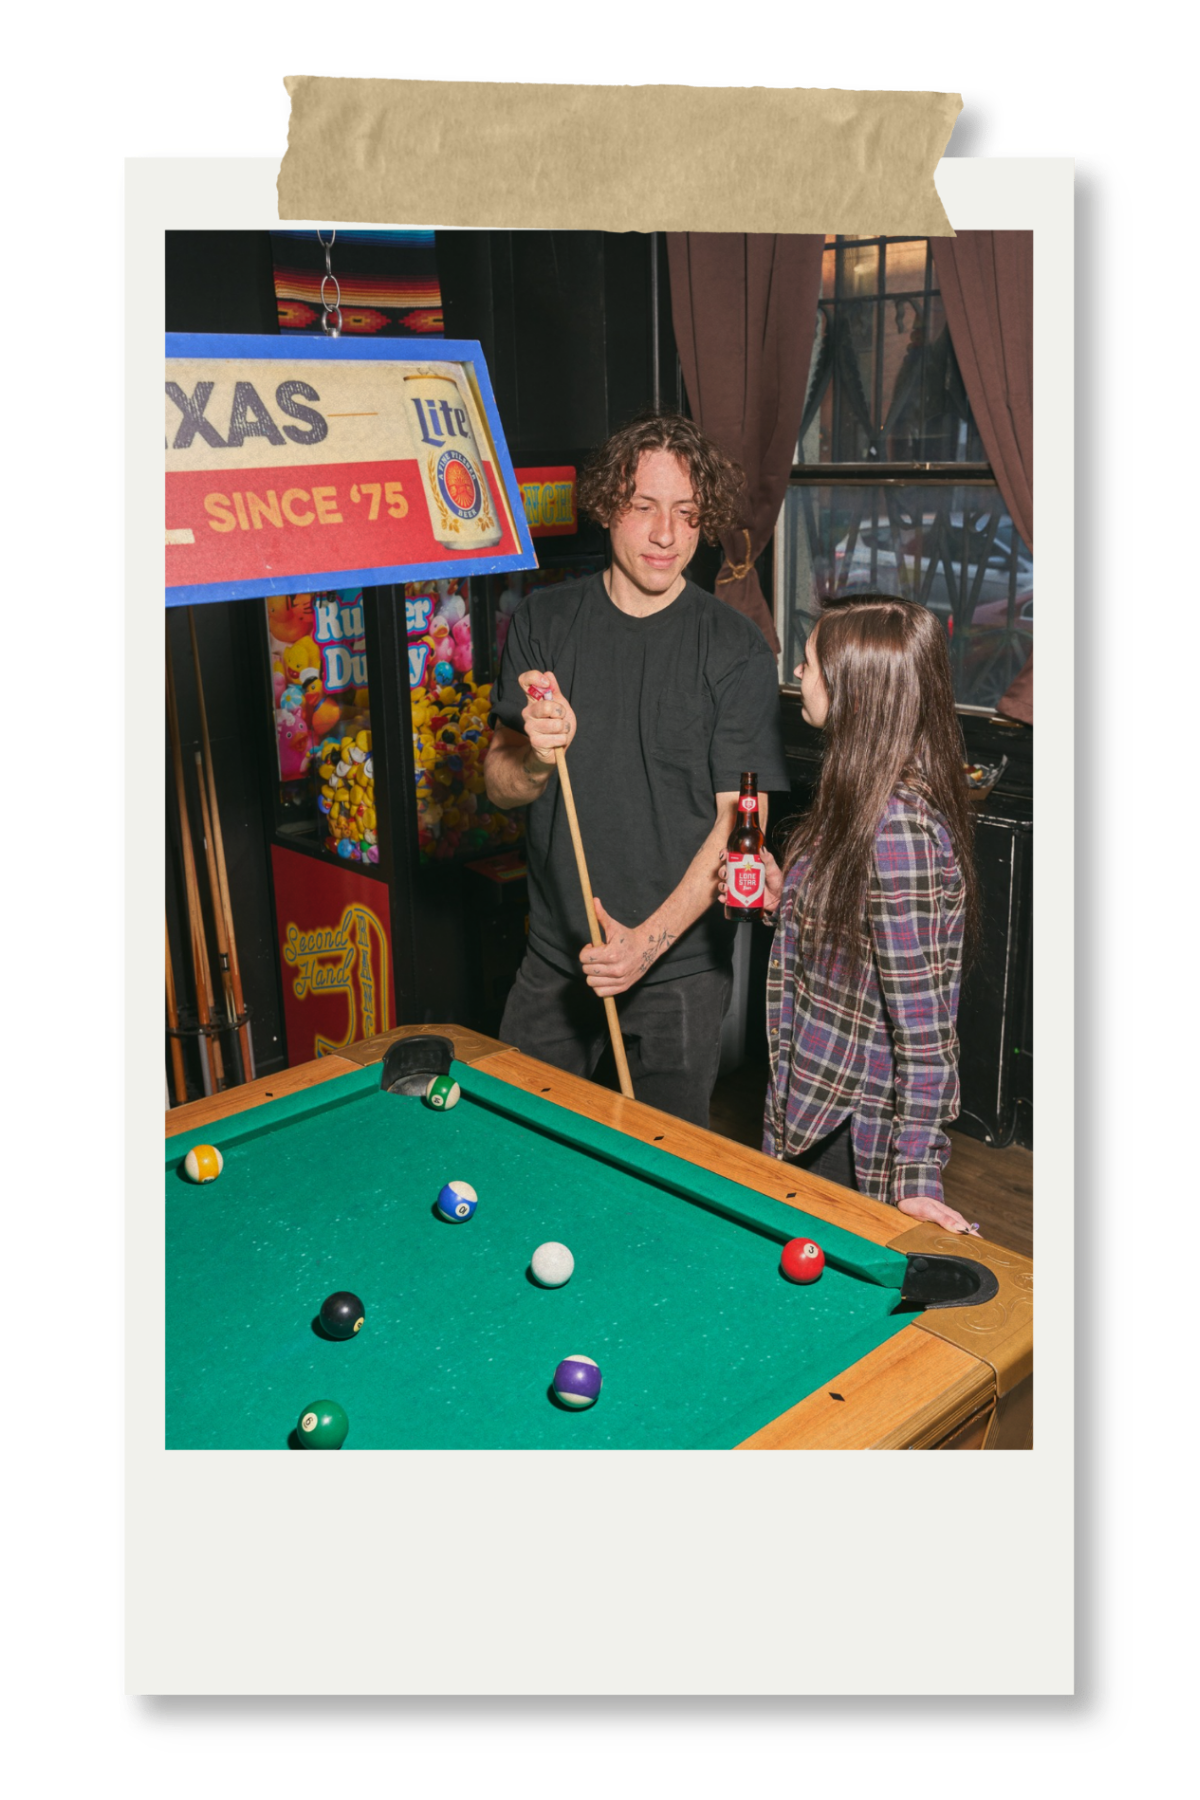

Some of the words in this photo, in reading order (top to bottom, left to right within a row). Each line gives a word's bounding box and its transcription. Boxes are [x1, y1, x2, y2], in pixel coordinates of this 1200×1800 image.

[165, 381, 329, 450] XAS
[411, 397, 469, 448] Lite
[438, 452, 452, 473] FINE
[204, 485, 344, 533] SINCE
[458, 508, 478, 519] BEER
[285, 910, 353, 963] Second
[295, 947, 354, 995] Hand
